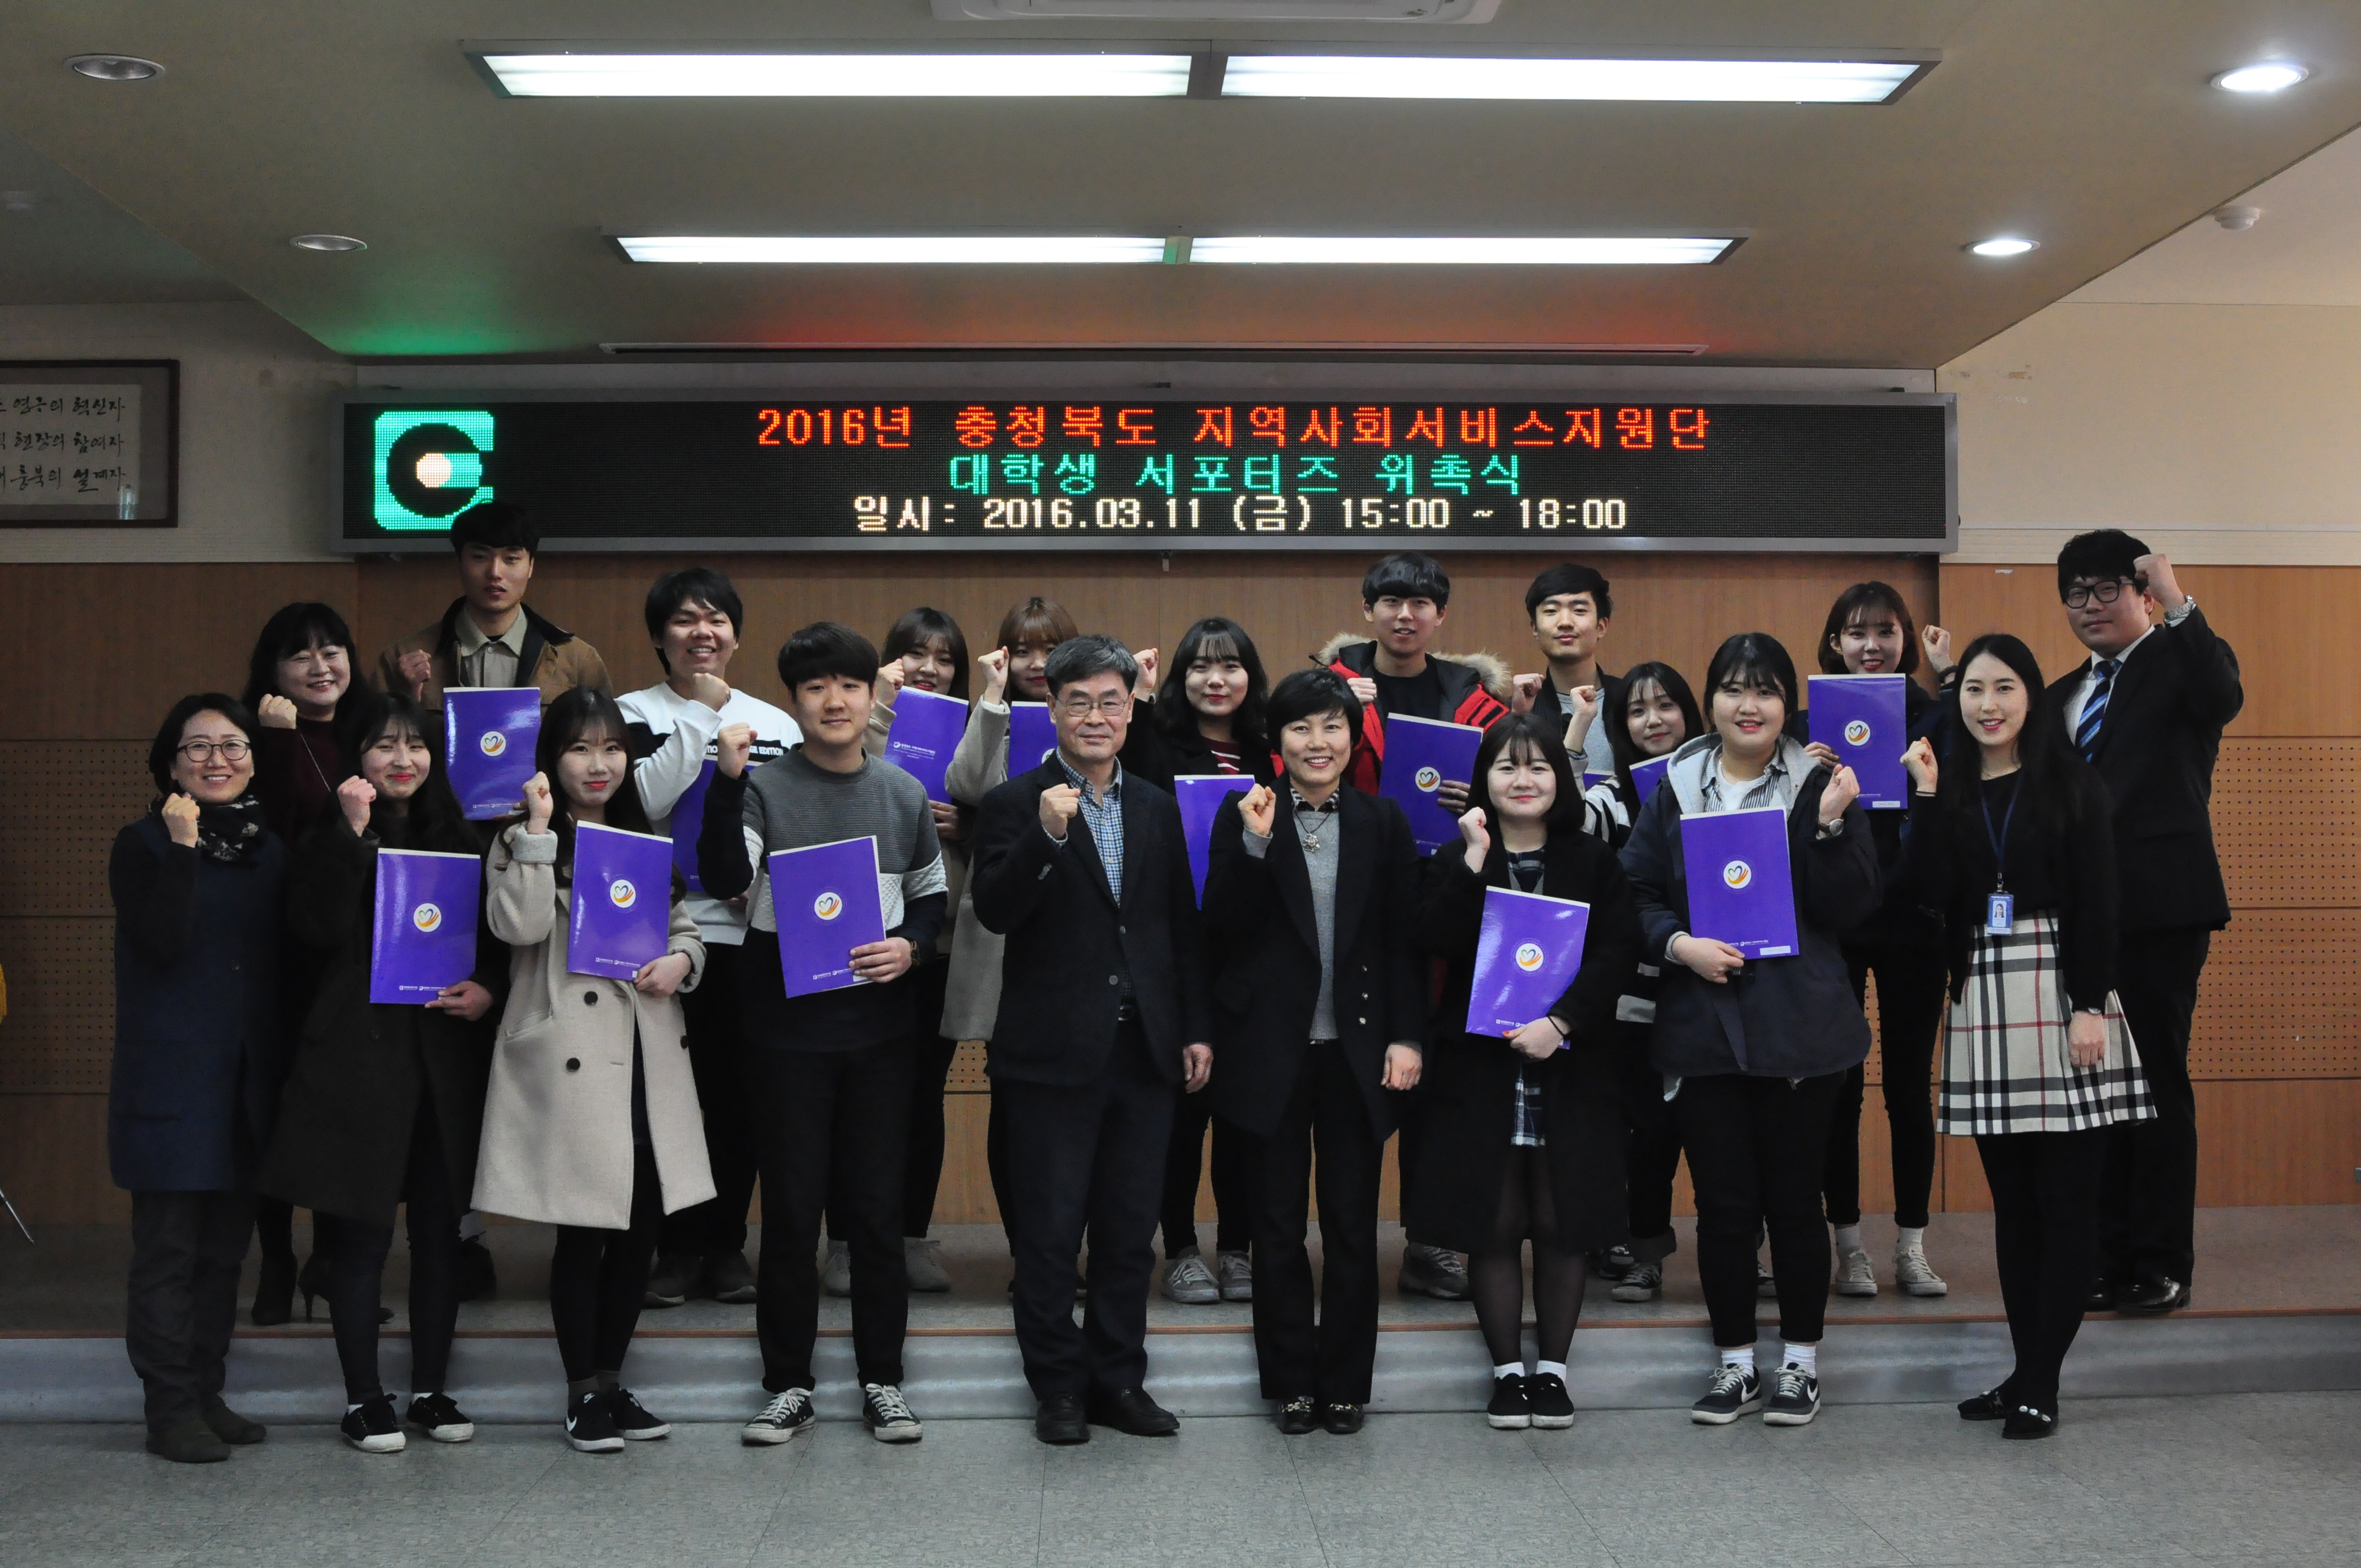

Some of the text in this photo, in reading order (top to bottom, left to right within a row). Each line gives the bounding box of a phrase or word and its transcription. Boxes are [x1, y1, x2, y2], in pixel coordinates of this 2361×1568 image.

[13, 395, 63, 415] 연구의
[72, 396, 126, 422] 혁신자
[758, 406, 1710, 450] 2016년 충청북도 지역사회서비스지원단
[14, 431, 65, 451] 현장의
[73, 431, 124, 457] 참여자
[10, 464, 61, 491] 충북의
[73, 466, 126, 493] 설계자
[949, 454, 1519, 497] 대학생 서포터즈 위촉식
[983, 498, 1199, 529] 2016.03.11
[1233, 495, 1310, 531] (금)
[1342, 498, 1449, 529] 15:00
[1520, 498, 1626, 529] 18:00
[759, 747, 784, 756] EDITION
